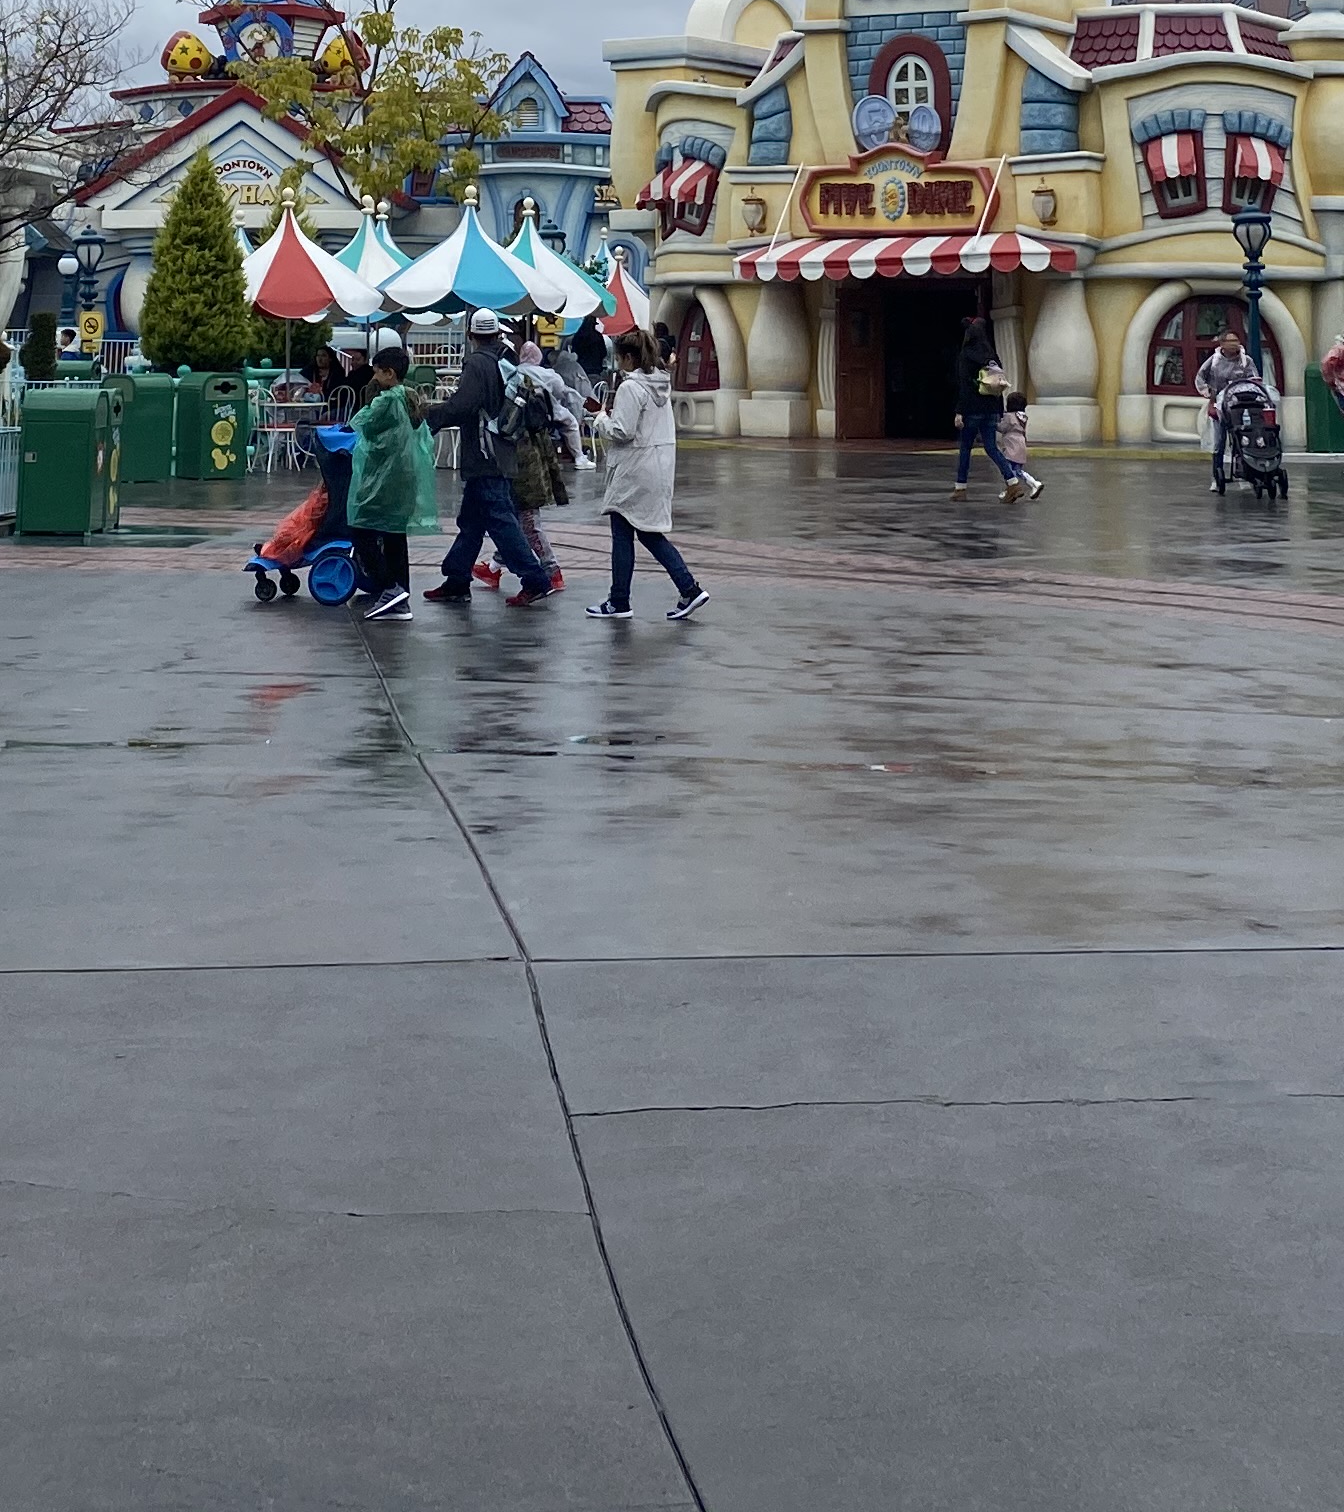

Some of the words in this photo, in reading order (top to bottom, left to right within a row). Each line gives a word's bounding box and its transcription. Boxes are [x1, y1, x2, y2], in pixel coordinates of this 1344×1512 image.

[216, 159, 274, 180] OONTOWN
[864, 159, 925, 180] TOONTOWN
[239, 183, 277, 206] HA
[819, 182, 876, 217] FIVE
[906, 180, 975, 216] DIME
